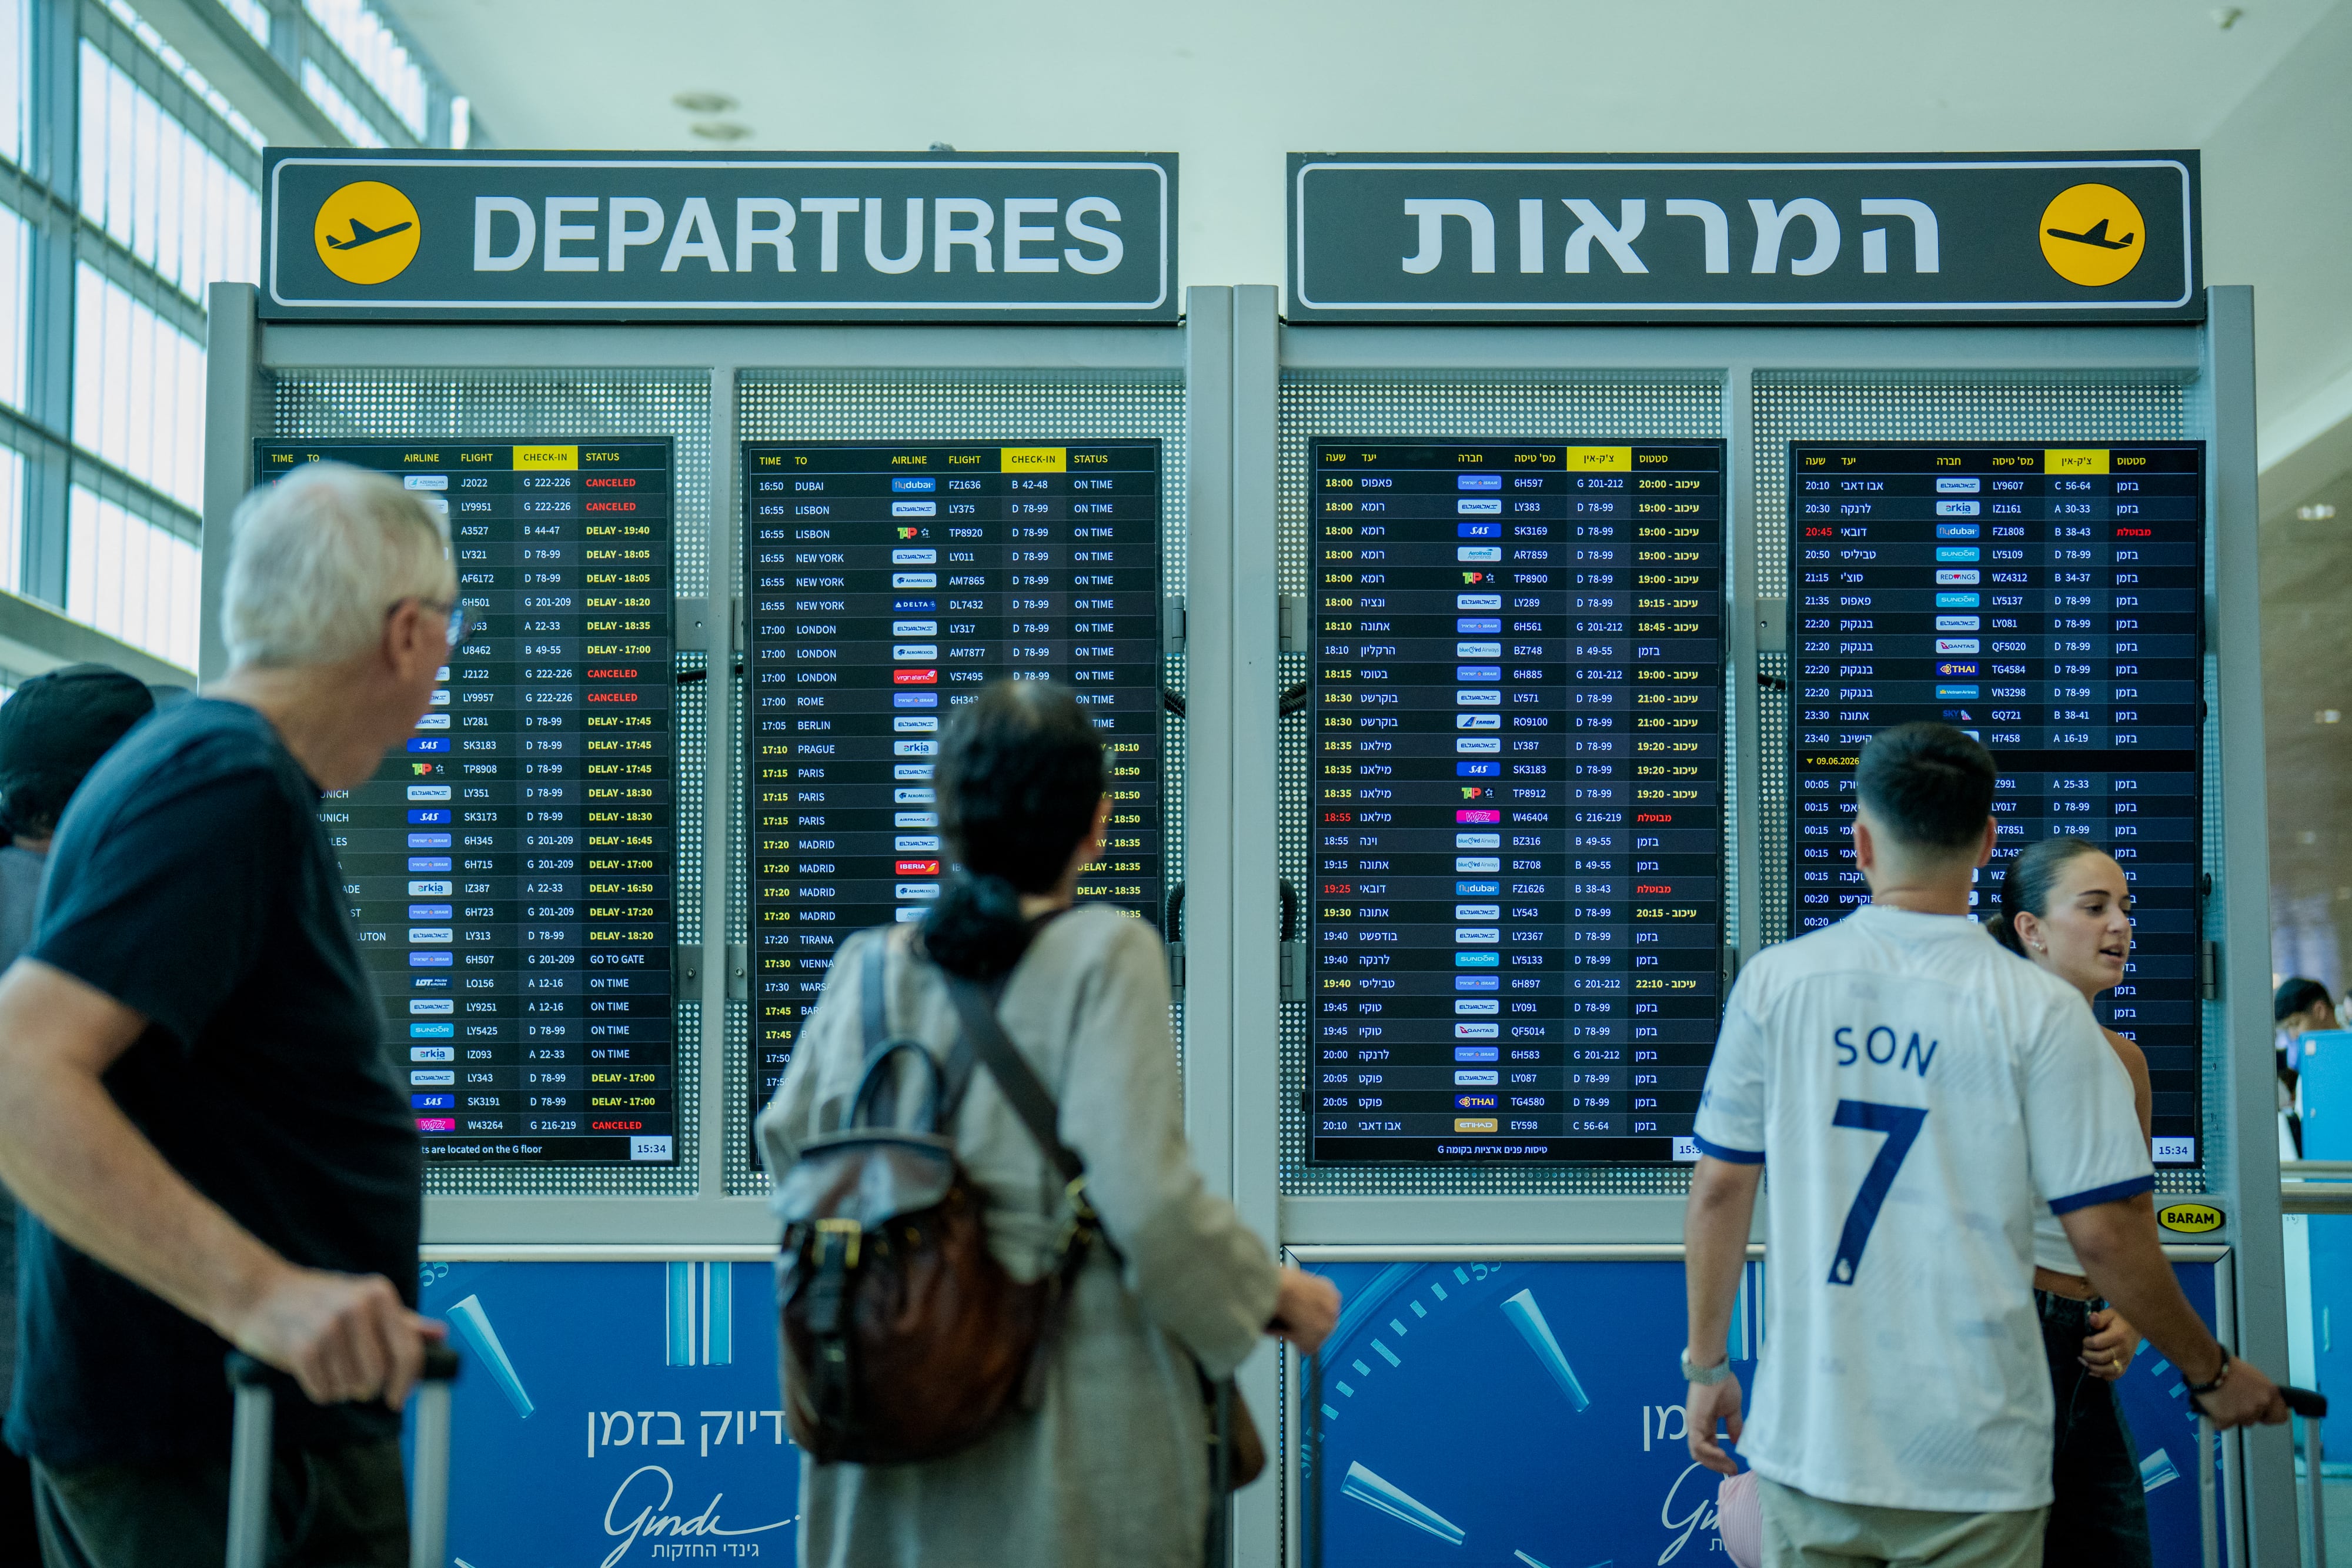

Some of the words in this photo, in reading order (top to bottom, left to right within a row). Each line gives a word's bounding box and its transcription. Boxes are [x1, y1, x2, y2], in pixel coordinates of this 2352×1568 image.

[473, 196, 1124, 275] DEPARTURES
[1402, 197, 1939, 275] המראות
[271, 454, 293, 463] TIME
[307, 454, 320, 463] TO
[404, 453, 440, 462] AIRLINE
[461, 453, 493, 462] FLIGHT
[586, 453, 620, 461] STATUS
[759, 457, 781, 465] TIME
[794, 456, 807, 465] TO
[891, 456, 927, 464] AIRLINE
[948, 456, 981, 464] FLIGHT
[1011, 455, 1055, 463] CHECK-IN
[1074, 454, 1108, 463] STATUS
[1326, 453, 1346, 462] שעה
[1458, 454, 1482, 462] חברה
[1514, 454, 1537, 463] טיסה
[1539, 453, 1556, 463] מס'
[1806, 457, 1826, 466] שעה
[1840, 457, 1856, 466] יעד
[1937, 457, 1961, 466] חברה
[1992, 457, 2015, 466] טיסה
[2017, 456, 2034, 466] מס'
[2117, 457, 2146, 466] סטטוס
[460, 478, 487, 487] J2022
[523, 478, 530, 487] G
[534, 477, 571, 487] 222-226
[586, 479, 636, 487] CANCELED
[759, 482, 784, 491] 16:50
[795, 482, 824, 491] DUBAI
[948, 480, 981, 490] FZ1636
[1011, 480, 1018, 489] B
[1022, 480, 1048, 489] 42-48
[1074, 480, 1088, 489] ON
[1090, 479, 1113, 489] TIME
[1325, 479, 1353, 487] 18:00
[1361, 478, 1392, 487] פאפוס
[1514, 478, 1544, 487] 6H597
[1577, 478, 1584, 488] G
[1588, 479, 1623, 488] 201-212
[1639, 480, 1667, 489] 20:00
[1675, 480, 1700, 489] עיכוב
[1806, 527, 1832, 536] 20:45
[1840, 527, 1867, 537] דובאי
[1992, 526, 2024, 536] FZ1808
[2054, 526, 2062, 536] B
[2065, 527, 2091, 536] 38-43
[2116, 527, 2151, 536] מבוטלת
[1805, 573, 1829, 582] 21:15
[1992, 572, 2028, 582] WZ4312
[2054, 572, 2062, 582] B
[2065, 572, 2091, 582] 34-37
[2116, 573, 2139, 586] בזמן
[761, 601, 785, 611] 16:55
[796, 601, 818, 610] NEW
[819, 600, 845, 610] YORK
[950, 600, 984, 609] DL7432
[1013, 599, 1020, 609] D
[1024, 599, 1049, 609] 78-99
[1074, 600, 1089, 609] ON
[1091, 599, 1114, 609] TIME
[1325, 646, 1349, 654] 18:10
[1361, 644, 1396, 657] הרקליון
[1481, 646, 1500, 654] Airways
[1514, 645, 1542, 655] BZ748
[1576, 646, 1583, 655] B
[1586, 646, 1612, 655] 49-55
[1638, 646, 1661, 658] בזמן
[1805, 641, 1830, 651] 22:20
[1840, 642, 1874, 654] בנגקוק
[1992, 641, 2026, 653] QF5020
[2054, 642, 2062, 651] D
[2065, 641, 2091, 651] 78-99
[2116, 642, 2139, 654] בזמן
[419, 741, 438, 750] SAS
[463, 740, 496, 750] SK3183
[526, 741, 533, 750] D
[537, 740, 562, 750] 78-99
[588, 741, 619, 750] DELAY
[626, 741, 652, 750] 17:45
[1816, 757, 1860, 765] 09.06.2026
[764, 864, 790, 873] 17:20
[799, 864, 835, 873] MADRID
[764, 935, 789, 944] 17:20
[800, 935, 834, 944] TIRANA
[590, 954, 604, 964] GO
[606, 954, 619, 964] TO
[620, 954, 644, 964] GATE
[415, 979, 433, 987] LOT
[528, 978, 535, 988] A
[539, 978, 563, 988] 12-16
[590, 978, 604, 988] ON
[606, 978, 629, 988] TIME
[467, 1026, 498, 1035] LY5425
[1834, 1025, 1939, 1077] SON
[1323, 1097, 1348, 1106] 20:05
[1358, 1098, 1382, 1109] פוקט
[1471, 1097, 1495, 1106] THAI
[1511, 1096, 1545, 1106] TG4580
[467, 1121, 503, 1129] W43264
[530, 1121, 537, 1130] G
[541, 1121, 576, 1130] 216-219
[592, 1121, 642, 1129] CANCELED
[1323, 1121, 1347, 1130] 20:10
[1358, 1122, 1382, 1131] דאבי
[1384, 1122, 1401, 1131] אבו
[1511, 1121, 1538, 1130] EY598
[1573, 1121, 1579, 1130] C
[1583, 1121, 1609, 1130] 56-64
[1635, 1121, 1657, 1133] בזמן
[447, 1144, 480, 1154] located
[495, 1144, 510, 1154] the
[512, 1145, 519, 1154] G
[520, 1144, 543, 1154] floor
[637, 1144, 666, 1153] 15:34
[1437, 1145, 1444, 1154] G
[1446, 1146, 1472, 1155] בקומה
[1524, 1146, 1548, 1154] טיסות
[1679, 1145, 1701, 1155] 15:3
[2159, 1146, 2188, 1155] 15:34
[1828, 1099, 1929, 1286] 7
[2167, 1212, 2214, 1225] BARAM
[588, 1411, 685, 1457] בזמן
[700, 1411, 800, 1457] דיוק
[652, 1544, 716, 1561] החזקות
[723, 1544, 759, 1557] גינדי
